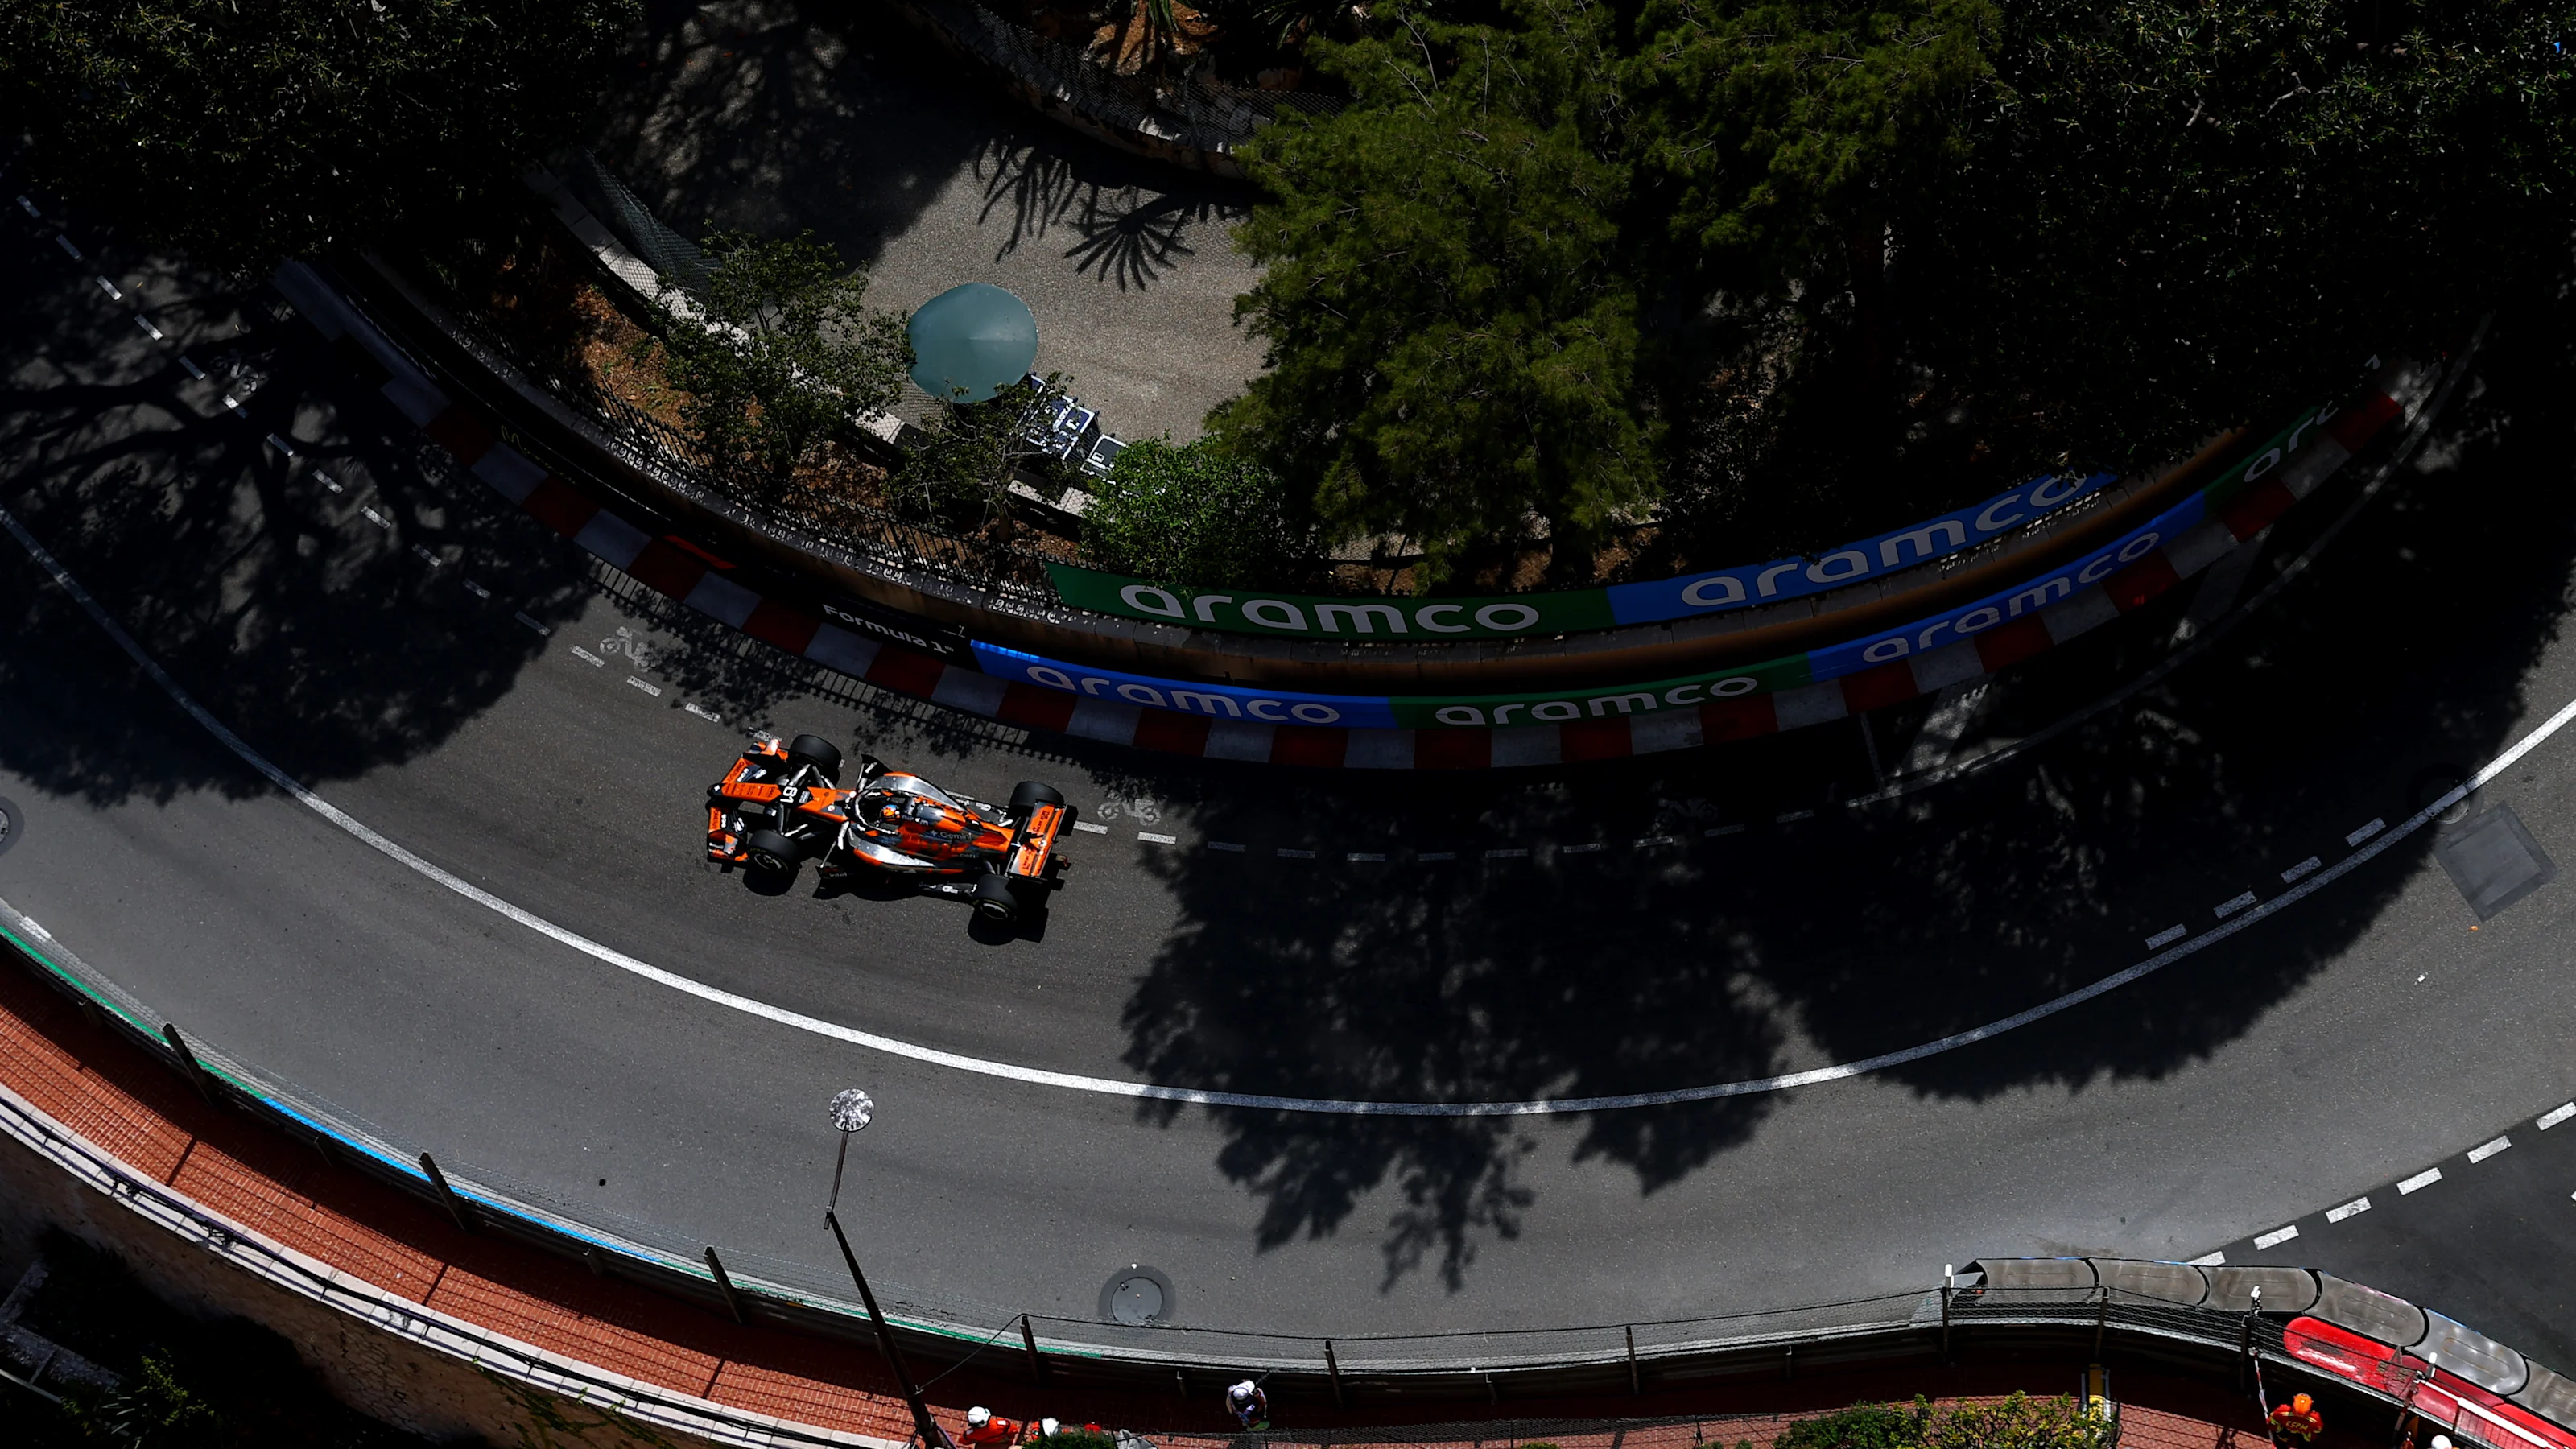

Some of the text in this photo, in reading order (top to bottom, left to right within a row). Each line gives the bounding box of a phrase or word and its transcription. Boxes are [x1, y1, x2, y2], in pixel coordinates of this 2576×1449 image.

[1681, 471, 2087, 607] aramco
[1120, 584, 1539, 634] aramco
[1863, 532, 2160, 663] aramco
[822, 604, 927, 647] Formula
[1026, 666, 1340, 724] aramco
[1435, 677, 1758, 724] aramco
[779, 786, 798, 803] 81
[939, 831, 972, 840] Gemini
[2285, 1420, 2309, 1430] CSPM
